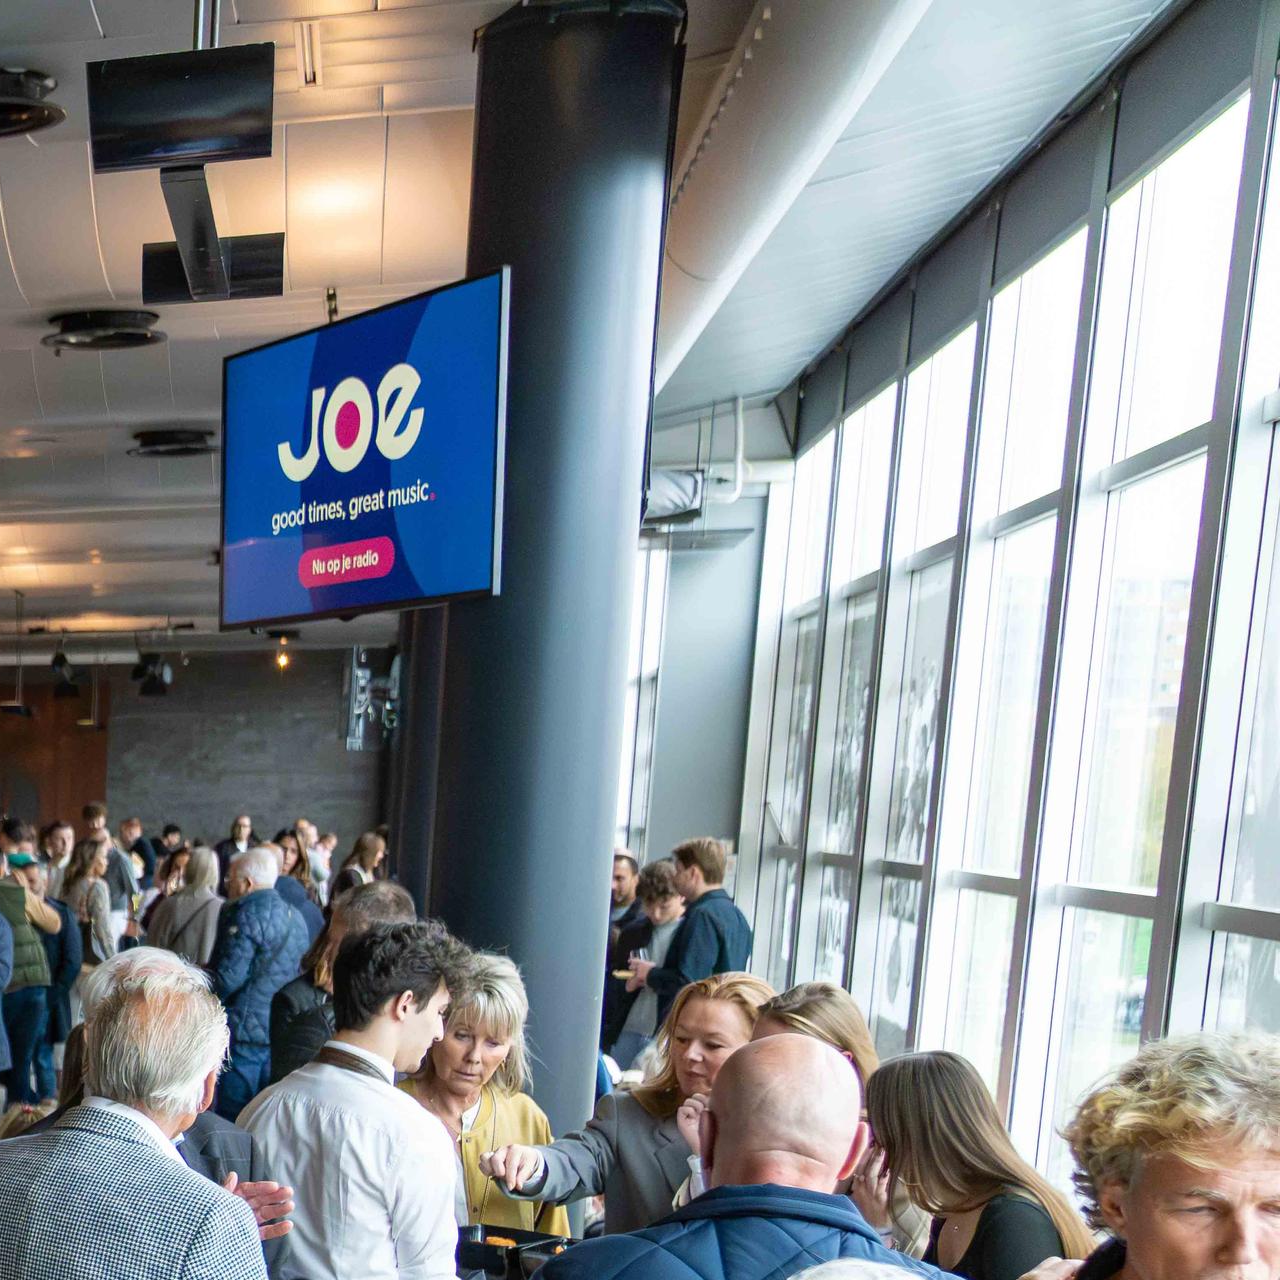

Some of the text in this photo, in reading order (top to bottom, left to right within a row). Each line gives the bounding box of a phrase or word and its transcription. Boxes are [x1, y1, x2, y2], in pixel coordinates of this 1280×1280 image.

[272, 503, 306, 536] good
[308, 500, 346, 523] times,
[349, 488, 385, 521] great
[312, 549, 379, 575] Nu op je radio
